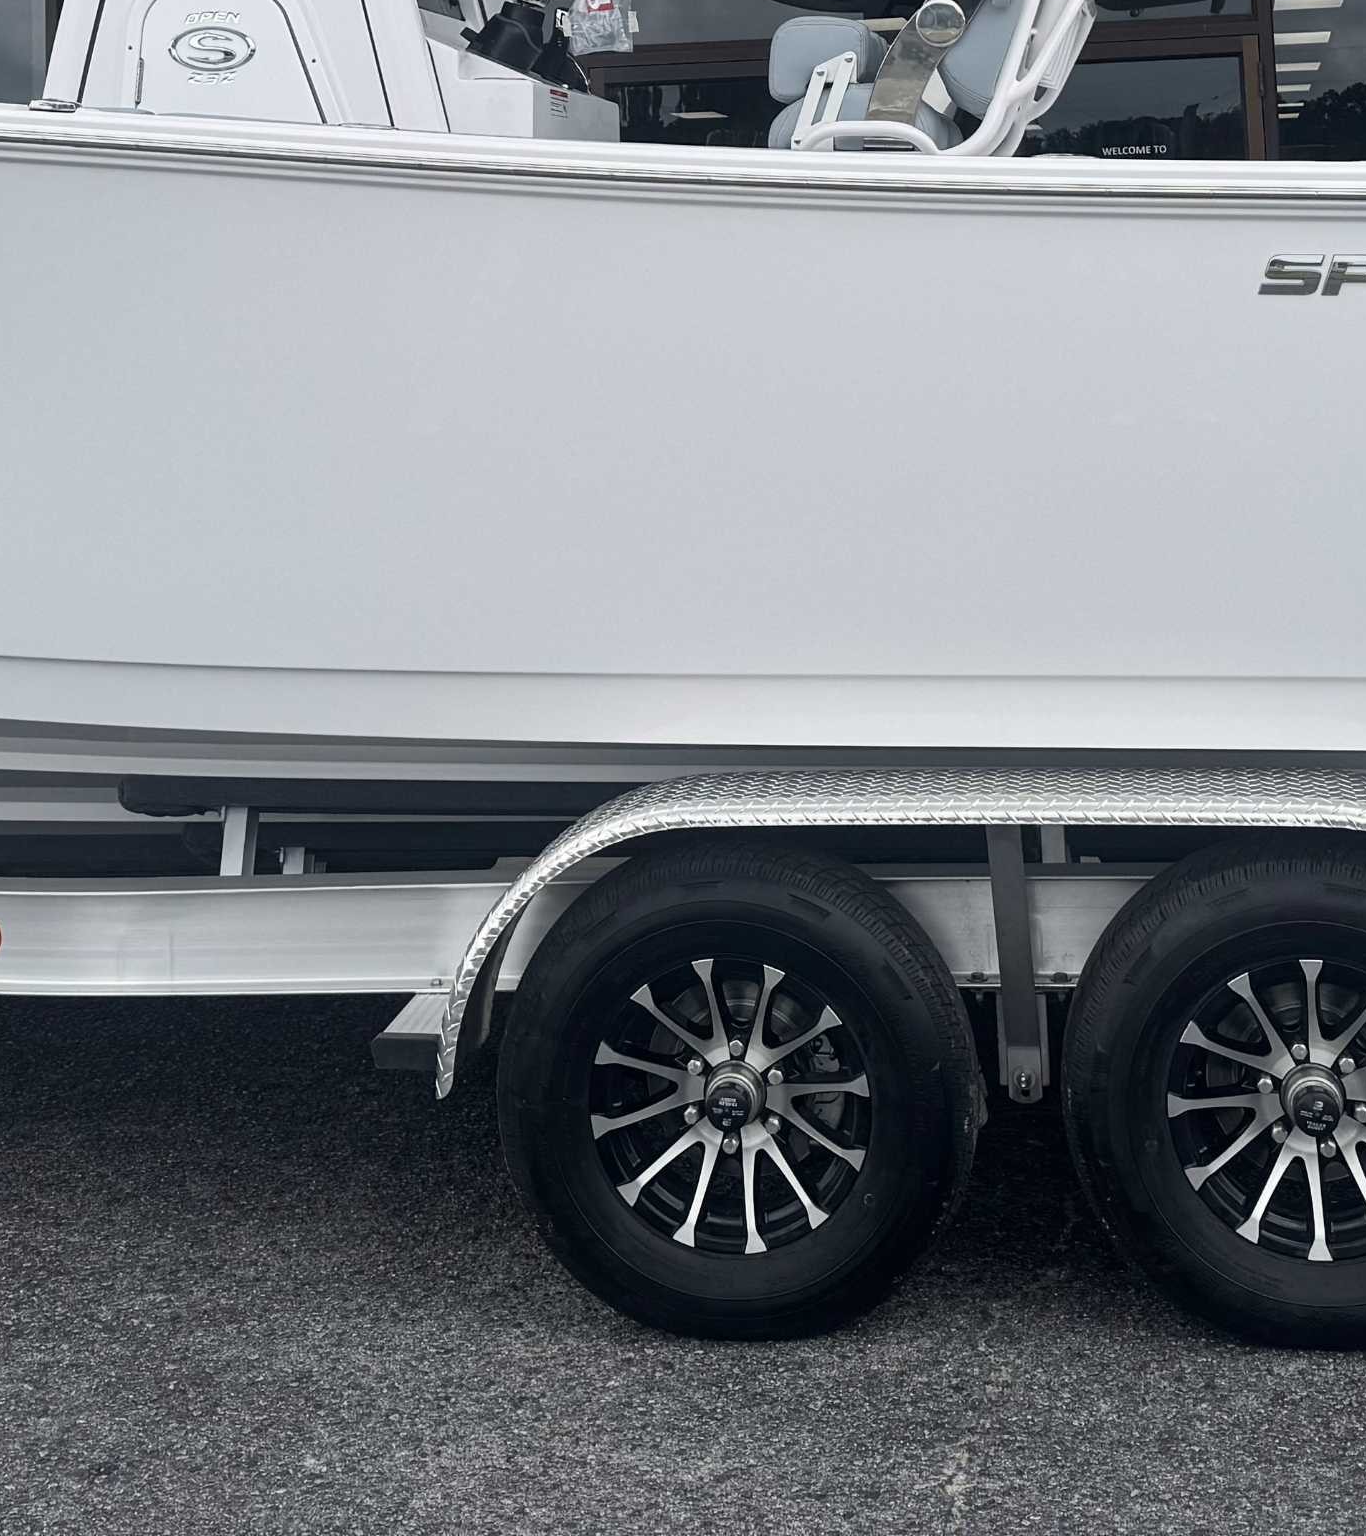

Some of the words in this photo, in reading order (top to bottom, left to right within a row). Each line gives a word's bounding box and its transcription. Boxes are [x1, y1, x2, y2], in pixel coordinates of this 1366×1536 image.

[185, 11, 240, 24] OPEN
[1102, 146, 1151, 155] WELCOME
[1154, 145, 1167, 154] TO
